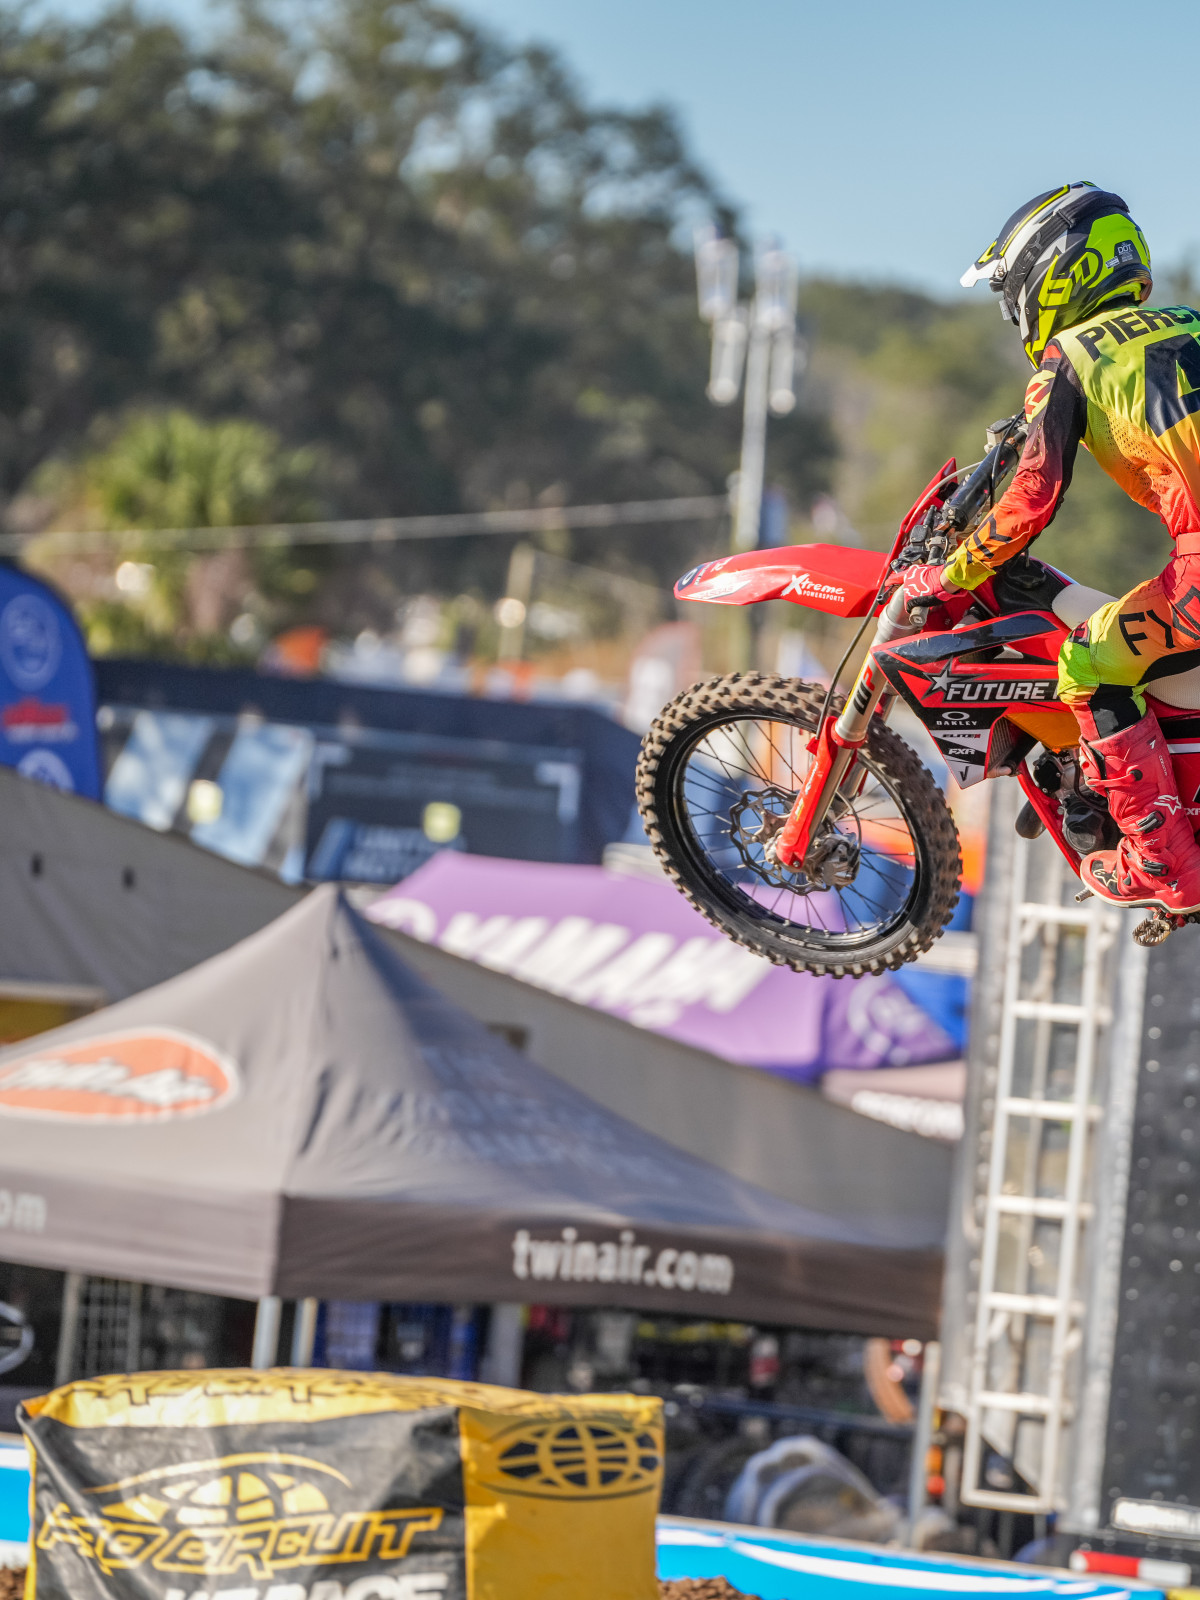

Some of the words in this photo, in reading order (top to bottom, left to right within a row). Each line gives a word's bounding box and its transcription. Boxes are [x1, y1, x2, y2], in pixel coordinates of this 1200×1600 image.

[1117, 244, 1133, 255] DOT
[780, 572, 846, 596] Xtreme
[802, 589, 845, 603] POWERSPORTS
[946, 681, 1050, 701] FUTURE
[511, 1226, 735, 1295] twinair.com
